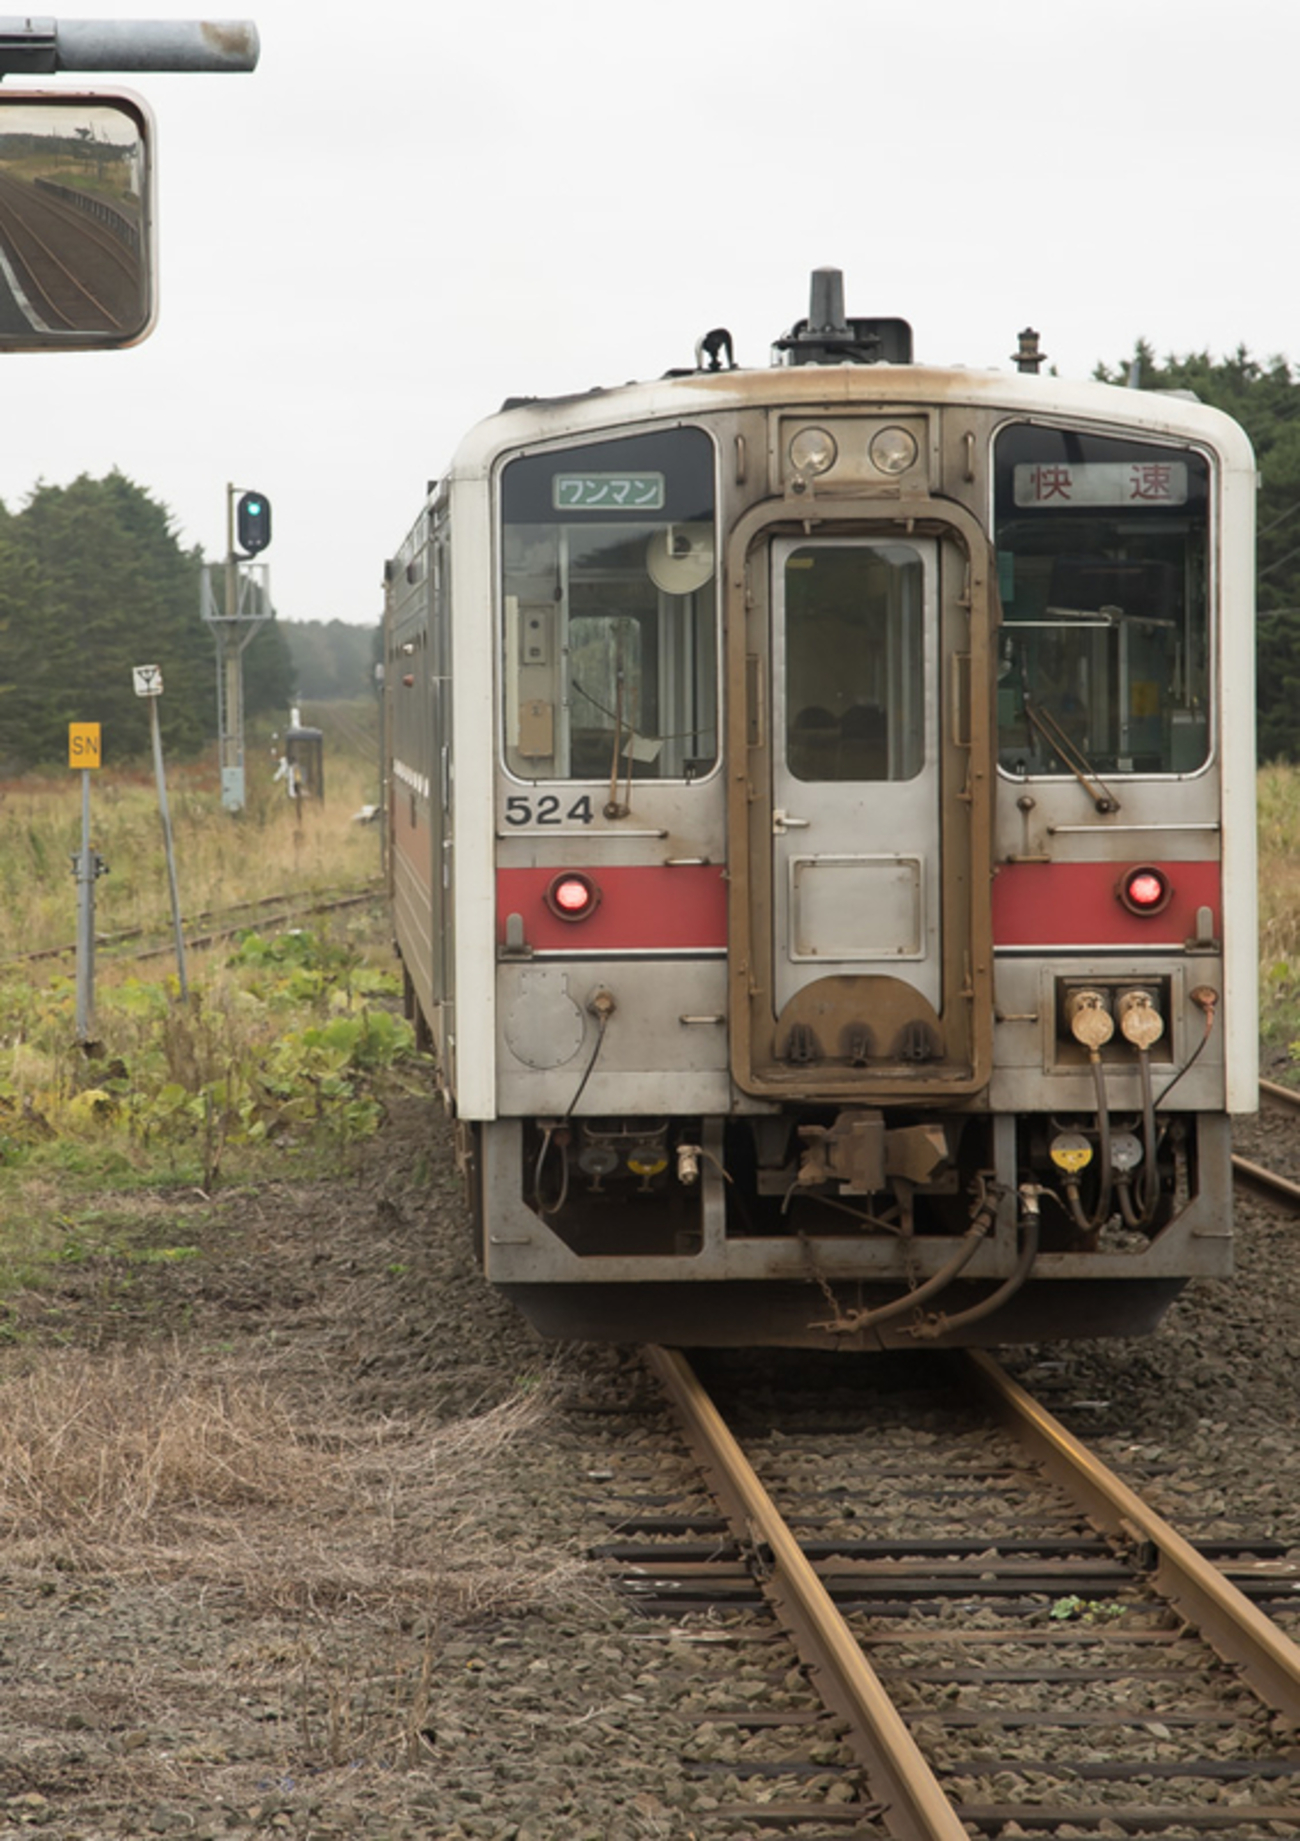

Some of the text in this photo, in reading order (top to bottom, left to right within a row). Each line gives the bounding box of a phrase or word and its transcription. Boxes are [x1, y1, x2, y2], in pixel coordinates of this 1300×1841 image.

[561, 480, 657, 503] ワンマン
[1030, 464, 1172, 500] 快速
[73, 736, 98, 755] SN
[505, 795, 594, 827] 524
